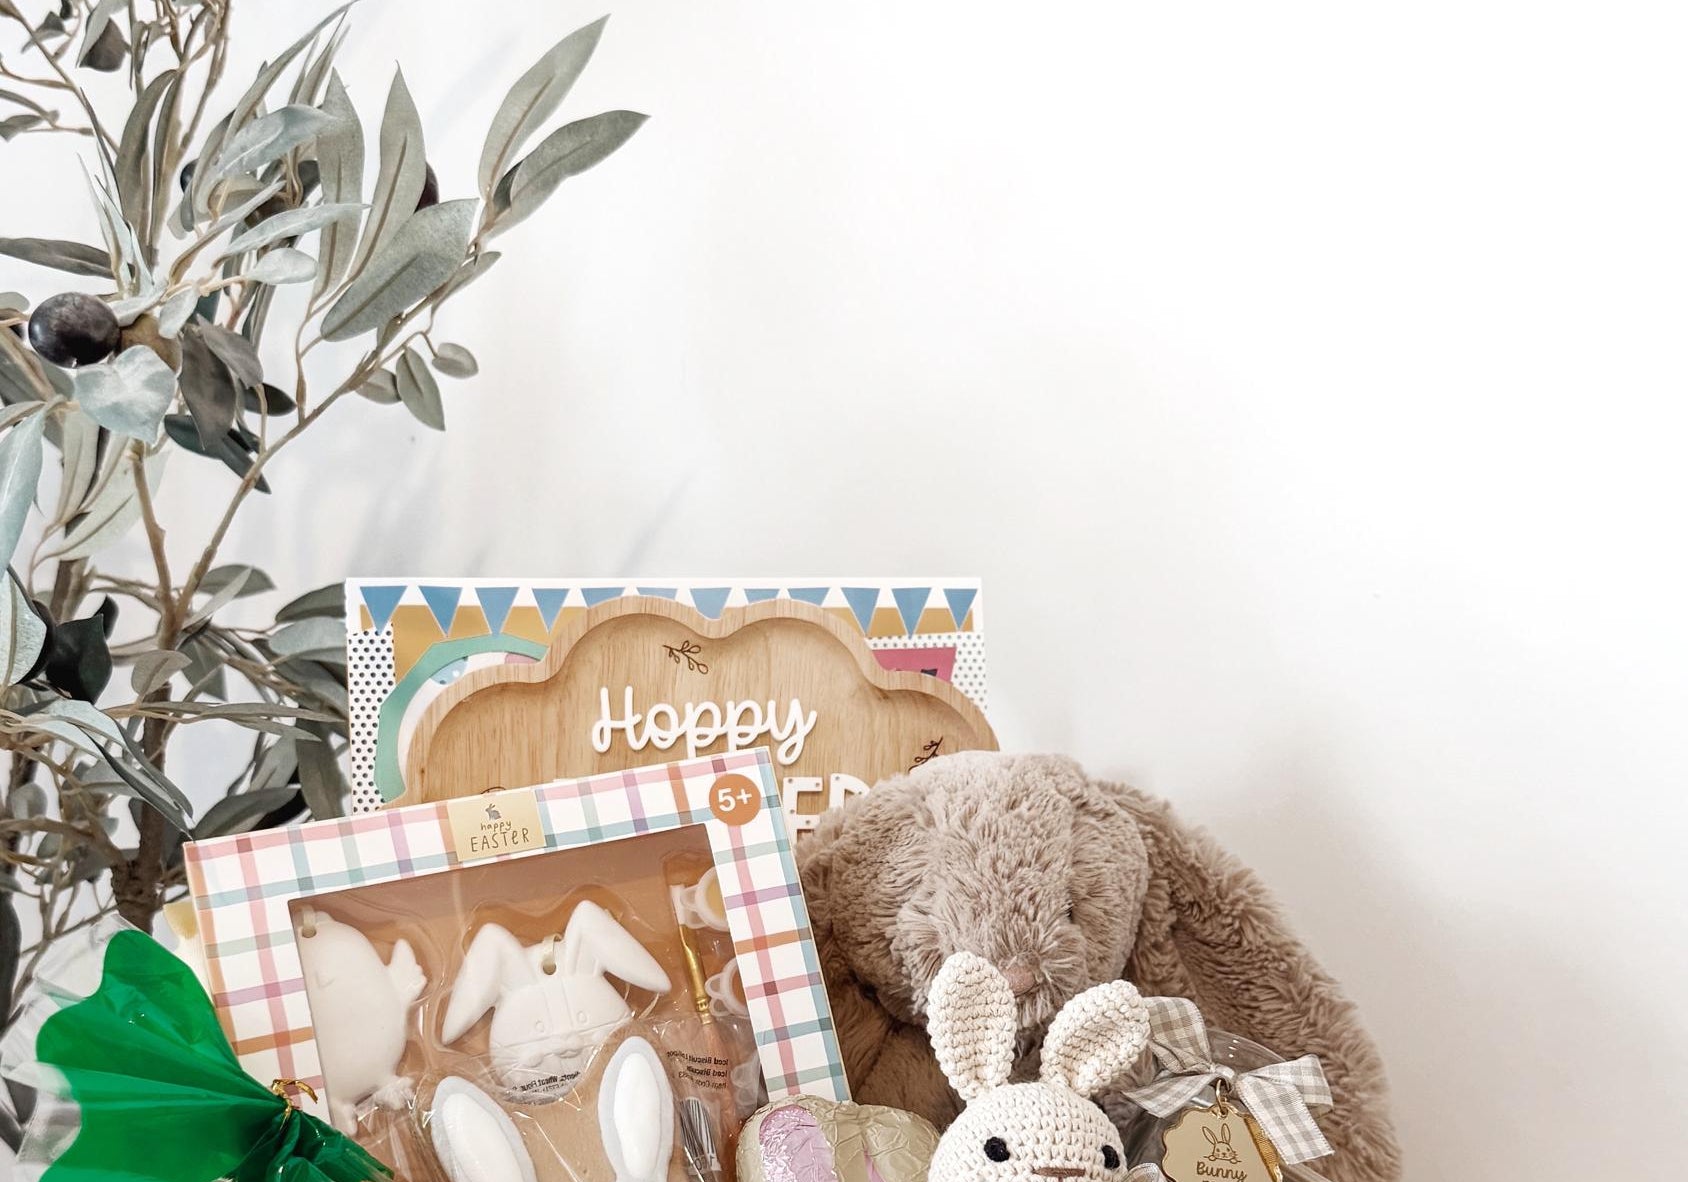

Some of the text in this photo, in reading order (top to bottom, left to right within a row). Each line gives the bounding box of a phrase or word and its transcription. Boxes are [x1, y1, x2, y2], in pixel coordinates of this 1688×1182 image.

[592, 685, 818, 766] Hoppy
[717, 787, 752, 812] 5+
[480, 820, 512, 832] happy
